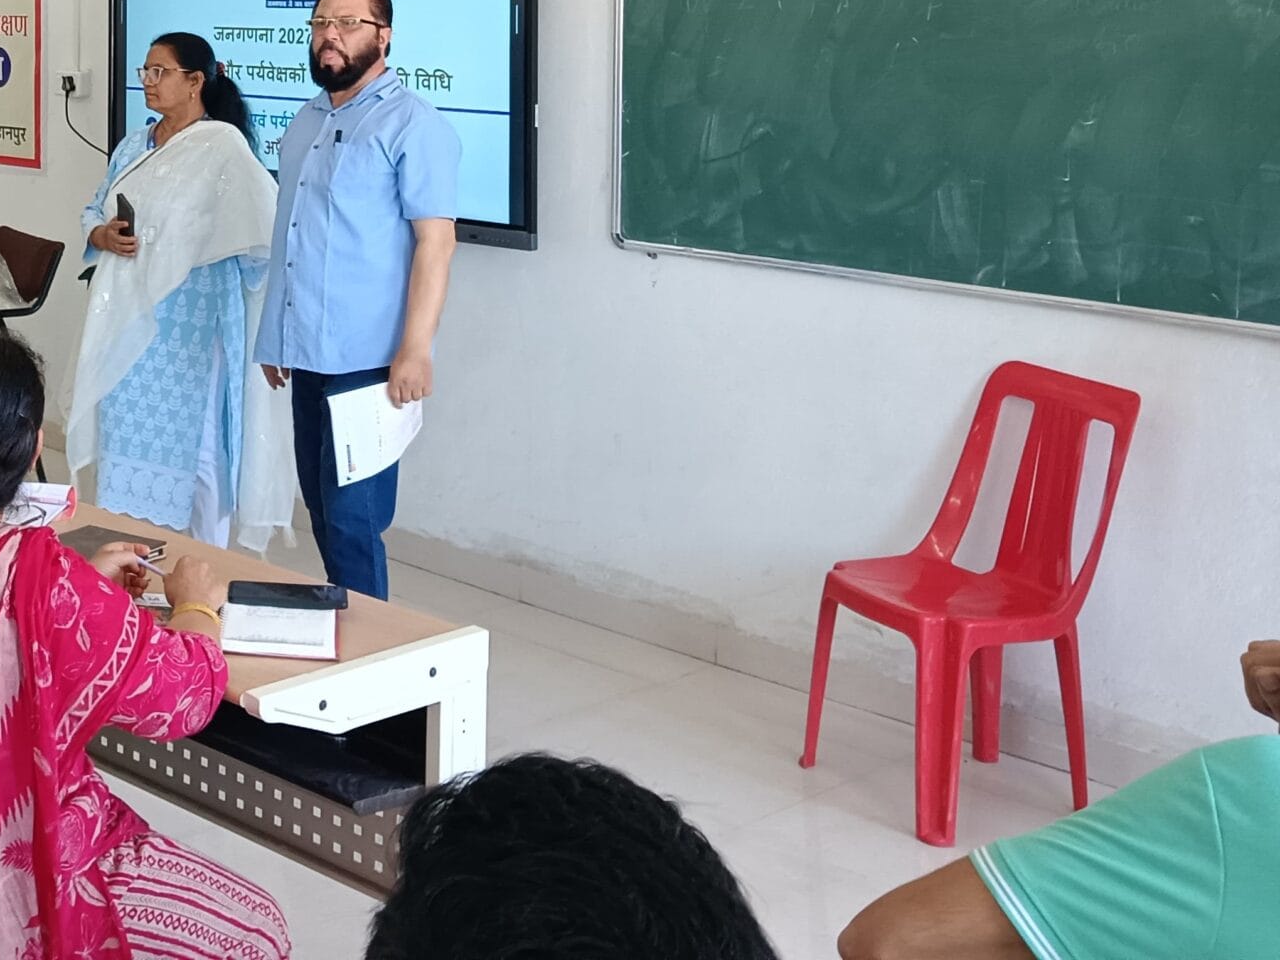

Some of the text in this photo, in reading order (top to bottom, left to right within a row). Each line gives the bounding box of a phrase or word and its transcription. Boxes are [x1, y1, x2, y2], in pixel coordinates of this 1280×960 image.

[213, 26, 275, 43] जनगणना
[246, 60, 307, 83] पर्यवेक्षकों
[415, 68, 453, 92] विधि
